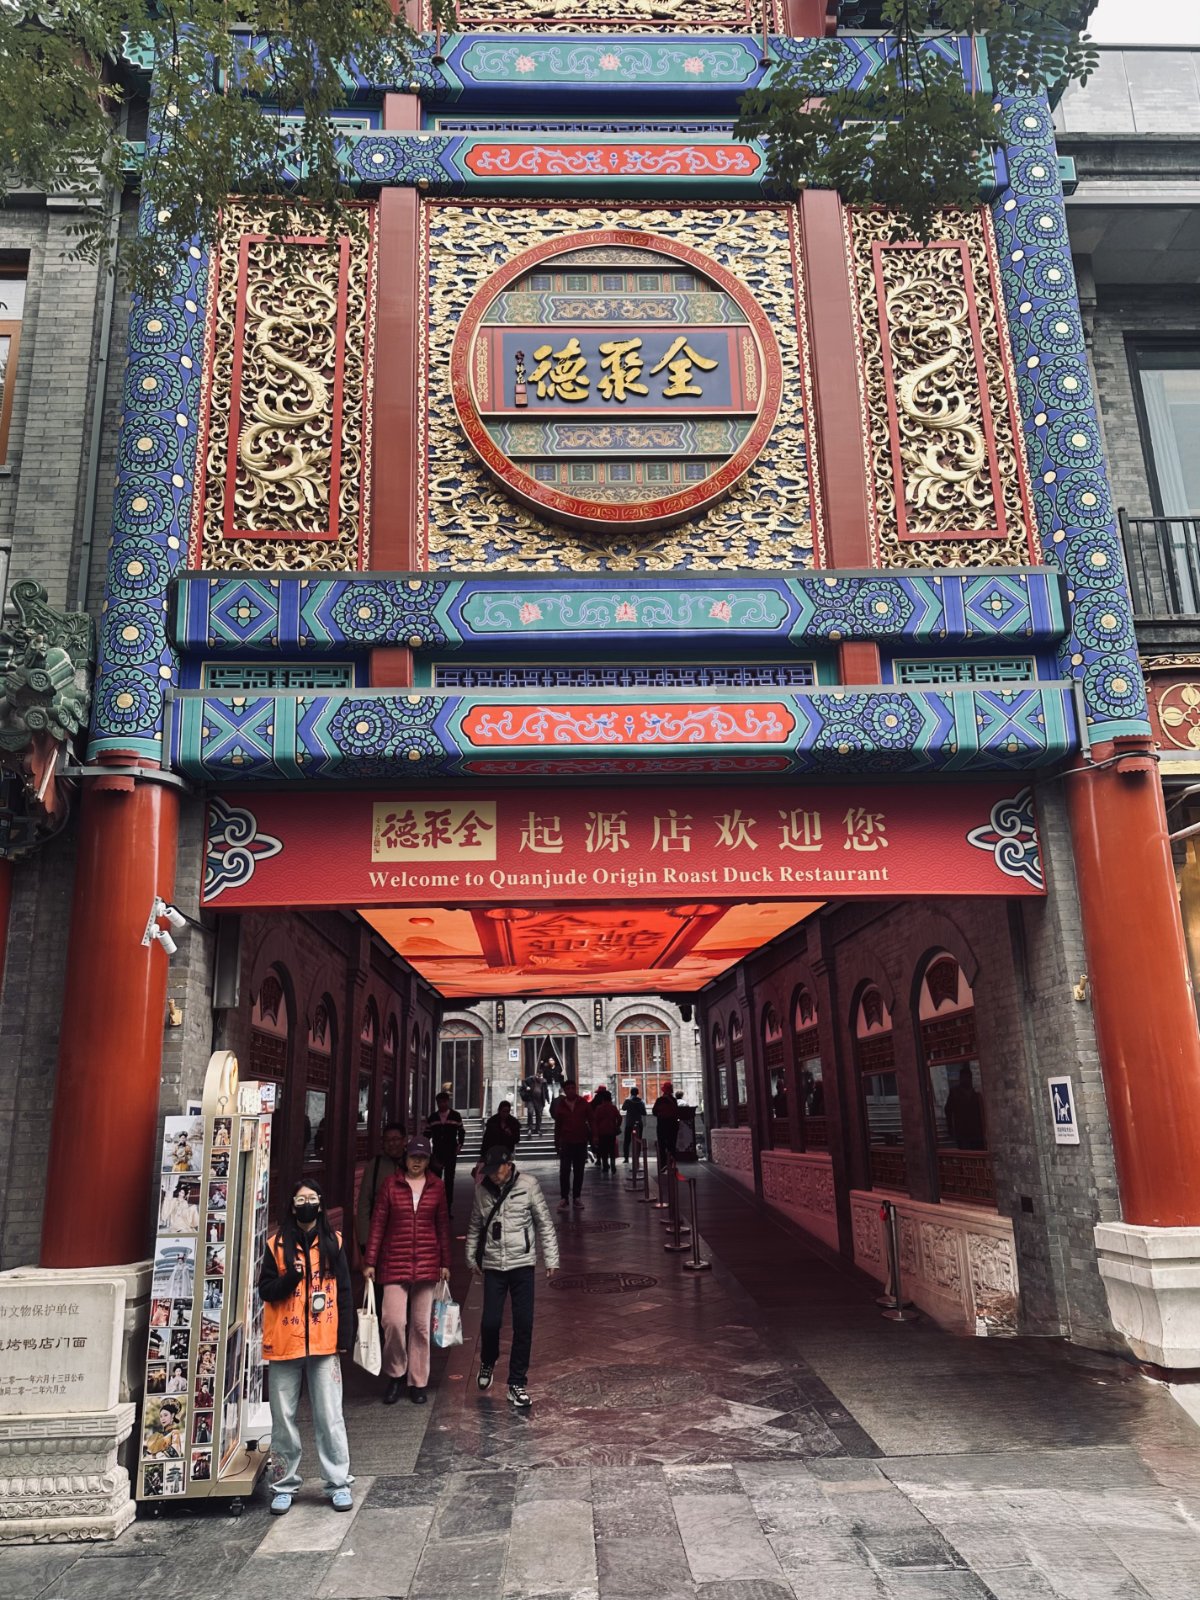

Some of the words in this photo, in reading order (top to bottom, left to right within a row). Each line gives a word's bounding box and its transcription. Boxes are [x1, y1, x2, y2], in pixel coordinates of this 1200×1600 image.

[518, 807, 889, 854] 起源店欢迎您
[368, 871, 460, 888] Welcome
[465, 873, 484, 887] to
[489, 868, 587, 889] Quanjude
[593, 867, 657, 888] Origin
[663, 867, 718, 884] Roast
[723, 866, 774, 883] Duck
[779, 866, 889, 882] Restaurant
[0, 1373, 85, 1385] 二零一一年六月十三日公布
